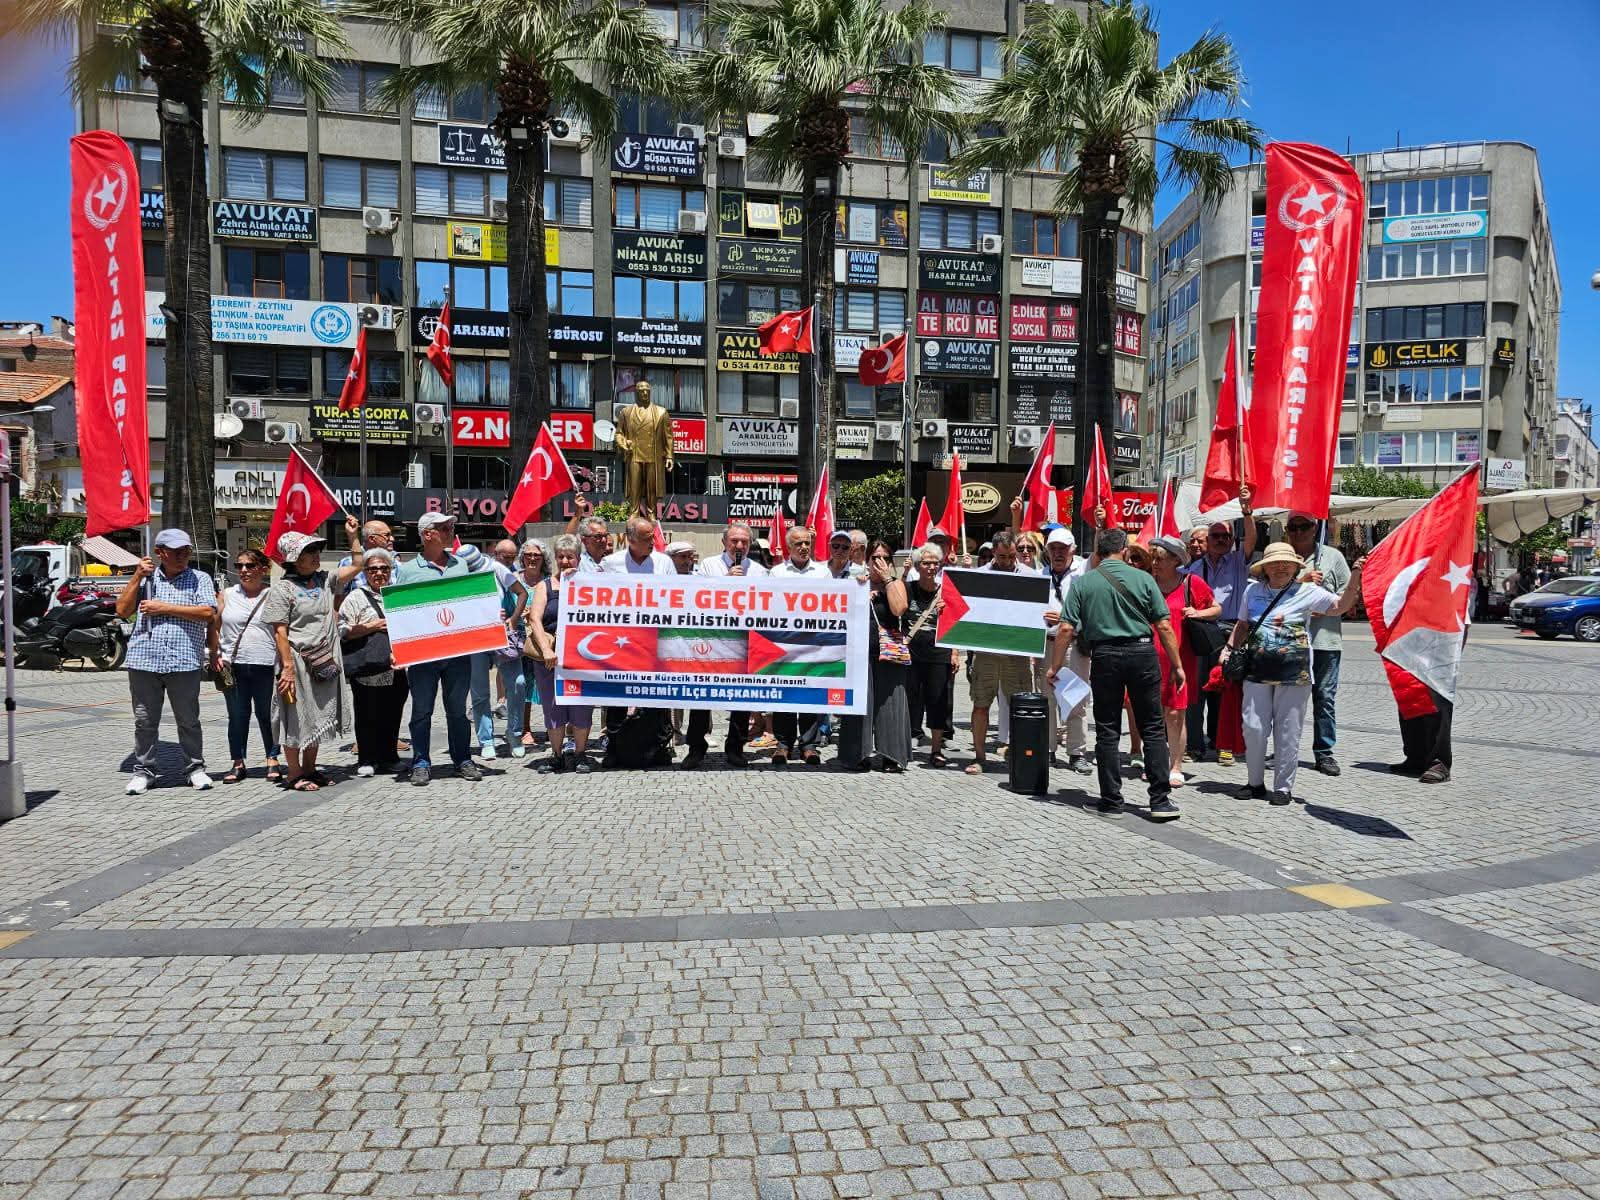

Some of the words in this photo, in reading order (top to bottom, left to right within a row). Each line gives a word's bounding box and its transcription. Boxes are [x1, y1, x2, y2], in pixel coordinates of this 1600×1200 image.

[646, 138, 694, 151] AVUKAT
[645, 153, 670, 164] BÜŞRA
[672, 156, 696, 165] TEKİN
[216, 202, 313, 223] AVUKAT
[222, 218, 247, 228] Zehra
[282, 223, 308, 232] KARA
[637, 237, 684, 250] AVUKAT
[617, 246, 657, 261] NİHAN
[850, 252, 878, 264] AVUKAT
[937, 259, 984, 271] AVUKAT
[1025, 261, 1051, 269] AVUKAT
[960, 274, 992, 282] KAPLAN
[217, 300, 249, 308] EDREMİT
[920, 297, 939, 312] AL
[946, 298, 970, 313] MAN
[977, 300, 995, 315] CA
[212, 311, 248, 319] LTINKUM
[1013, 303, 1046, 318] E.DİLEK
[225, 322, 253, 330] TAŞIMA
[256, 323, 306, 332] KOOPERATİFİ
[641, 322, 678, 331] Avukat
[921, 316, 938, 331] TE
[946, 315, 969, 332] RCÜ
[976, 319, 997, 334] ME
[1012, 324, 1045, 336] SOYSAL
[453, 324, 504, 337] ARASAN
[554, 327, 603, 342] BÜROSU
[617, 332, 655, 343] Serhat
[657, 334, 702, 345] ARASAN
[835, 339, 866, 348] UKAT
[946, 342, 992, 354] AVUKAT
[724, 350, 758, 358] YENAL
[353, 407, 408, 420] SGORTA
[728, 422, 798, 433] AVUKAT
[952, 428, 991, 436] AVUKAT
[1118, 447, 1140, 458] EMLAK
[734, 485, 782, 500] ZEYTİN
[568, 581, 684, 608] İSRAİL'E
[695, 586, 773, 616] GEÇİT
[784, 592, 848, 613] YOK!
[568, 610, 630, 623] TÜRKİYE
[636, 612, 672, 625] İRAN
[678, 613, 739, 627] FİLİSTİN
[745, 617, 788, 629] OMUZ
[794, 618, 847, 630] OMUZA
[604, 672, 638, 680] İncirlik
[654, 673, 690, 682] Kürecik
[625, 685, 678, 696] EDREMİT
[682, 685, 707, 698] İLÇE
[710, 688, 783, 700] BAŞKANLIĞI
